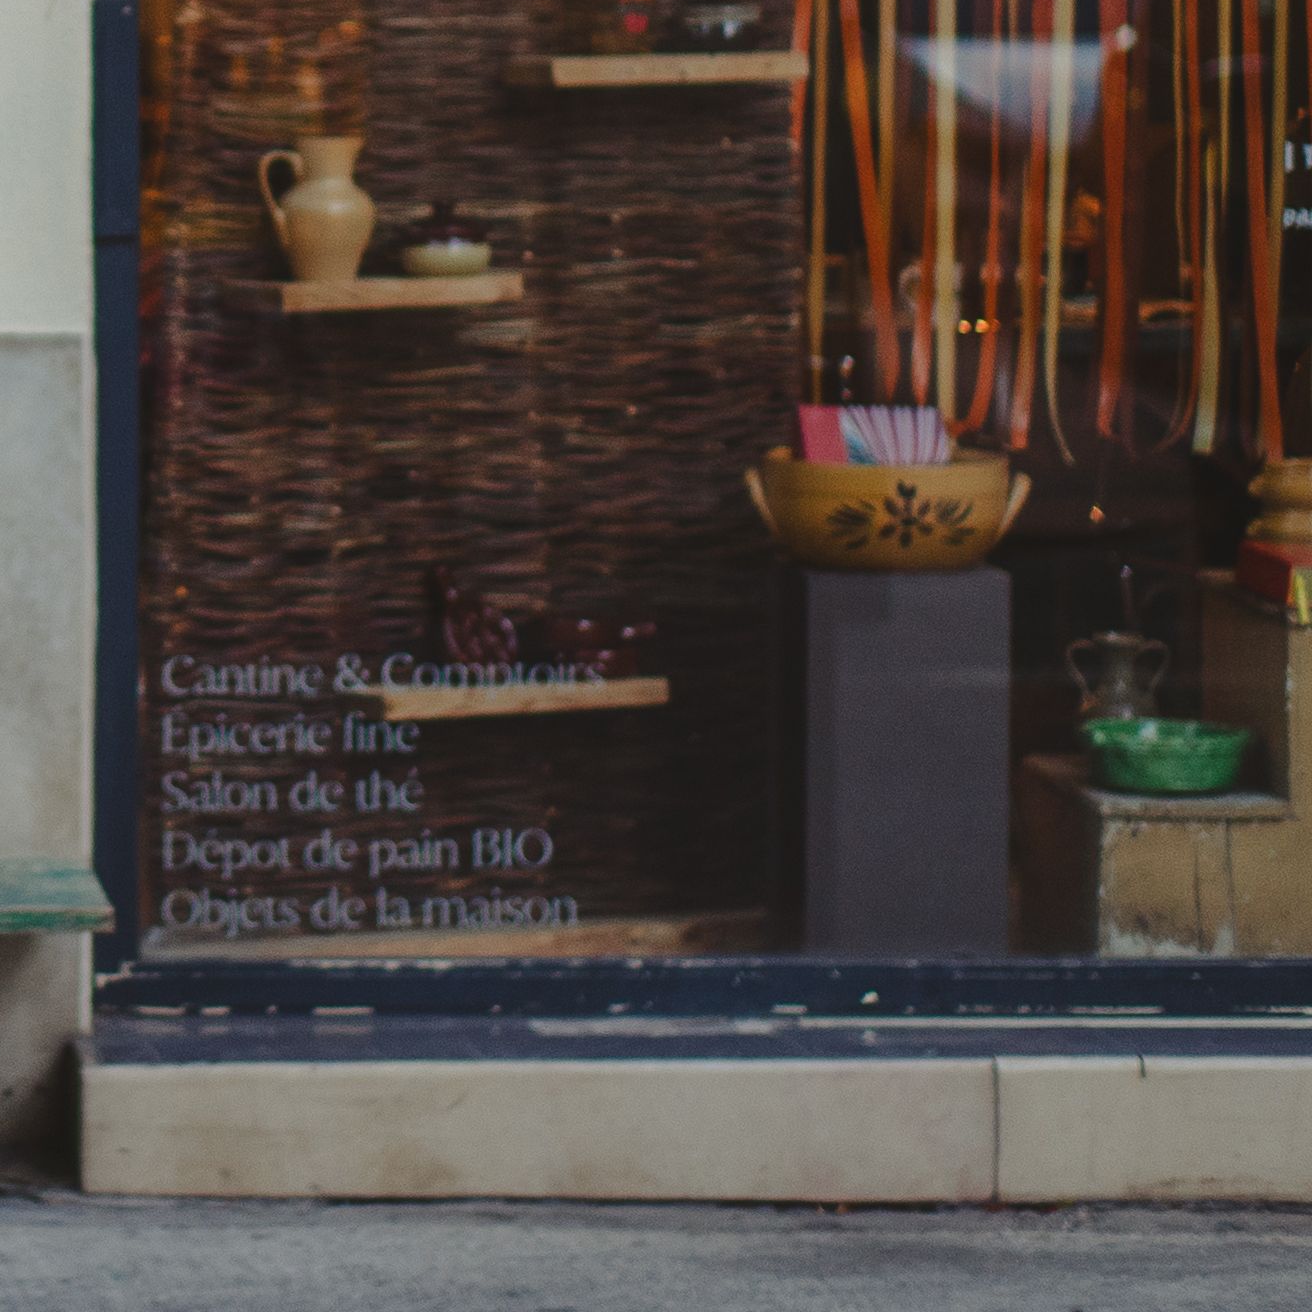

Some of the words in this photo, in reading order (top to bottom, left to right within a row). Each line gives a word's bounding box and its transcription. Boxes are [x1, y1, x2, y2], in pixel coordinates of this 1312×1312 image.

[161, 654, 325, 696] Cantine
[333, 652, 371, 692] &
[380, 652, 606, 702] Comptoirs
[341, 710, 421, 753] fine
[161, 769, 279, 812] Salon
[288, 769, 345, 812] de
[355, 766, 425, 812] thé
[303, 827, 359, 870] de
[368, 827, 460, 880] pain
[472, 826, 554, 870] BIO
[161, 887, 302, 938] Objets
[310, 887, 368, 930] de
[376, 886, 413, 929] la
[422, 886, 579, 930] maison
